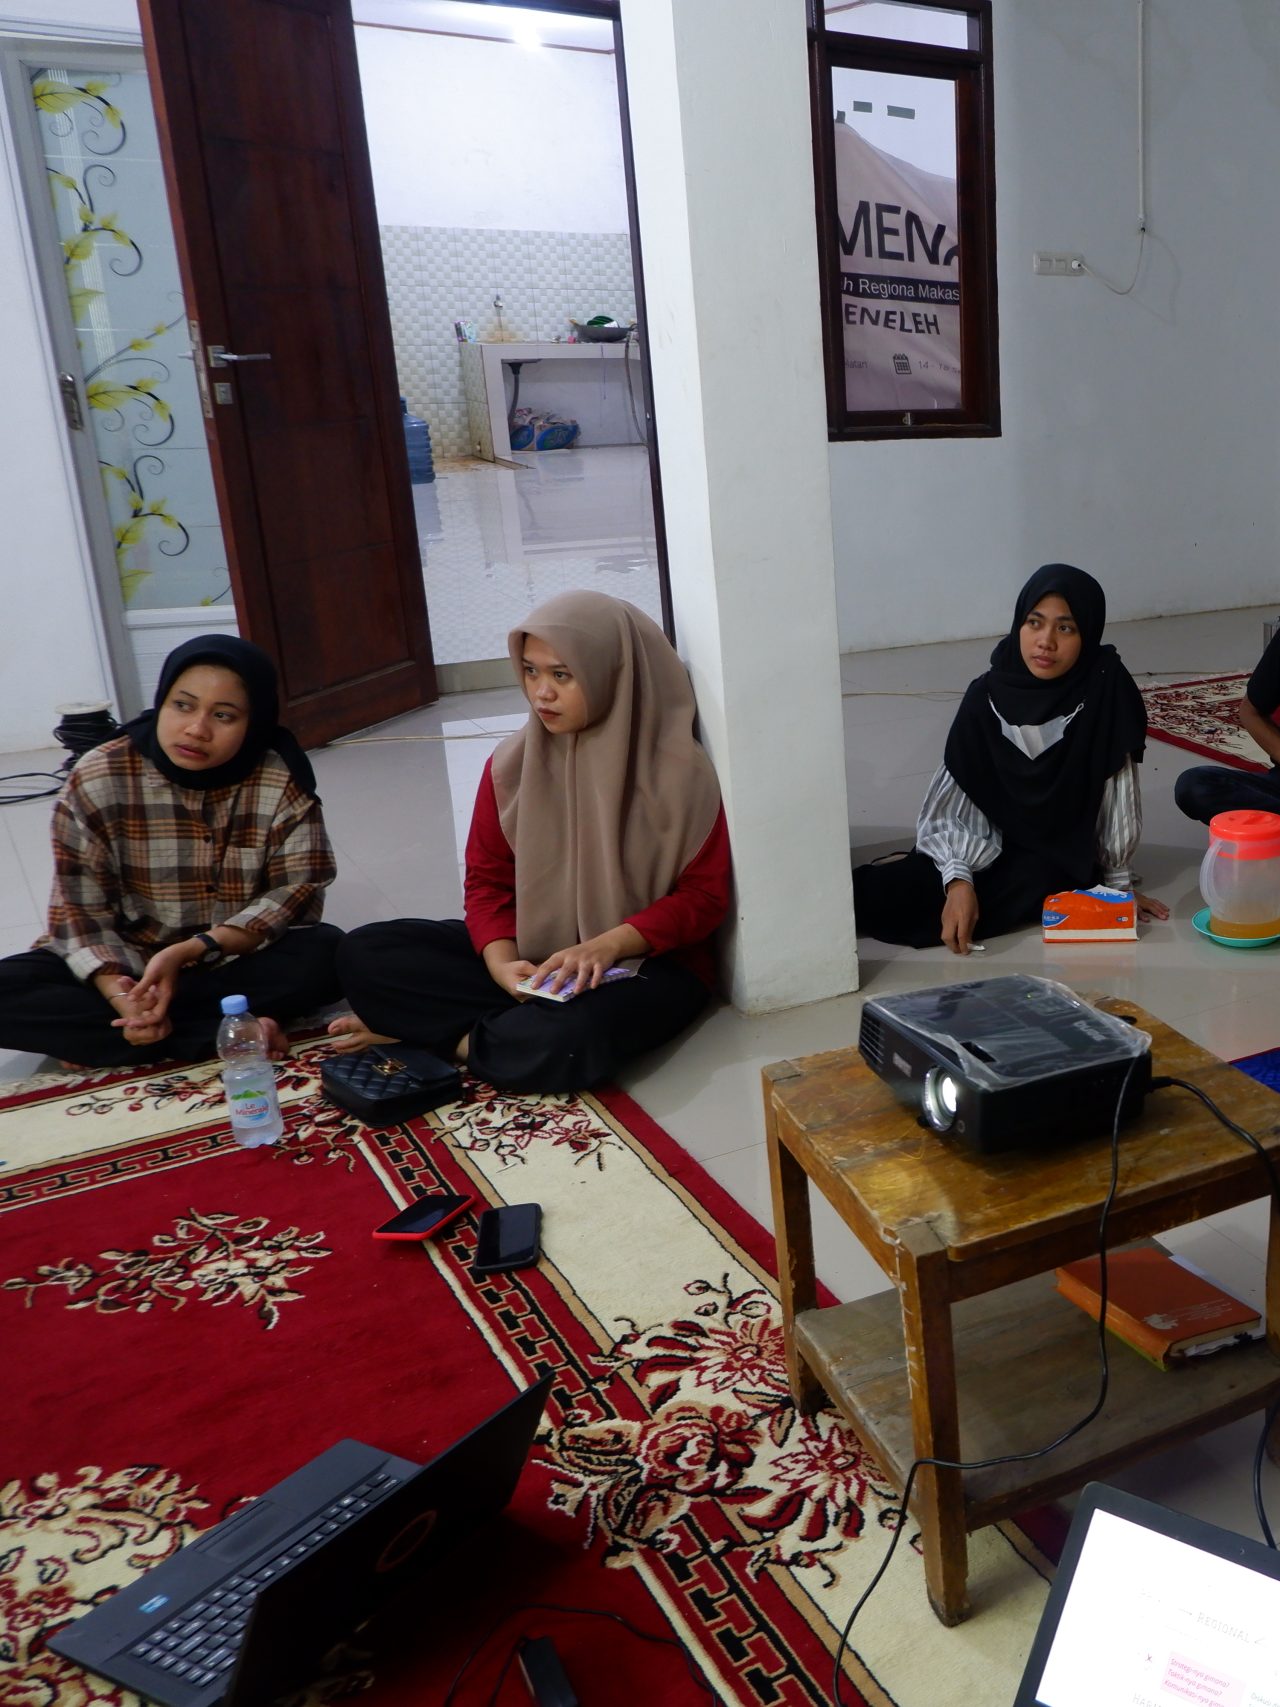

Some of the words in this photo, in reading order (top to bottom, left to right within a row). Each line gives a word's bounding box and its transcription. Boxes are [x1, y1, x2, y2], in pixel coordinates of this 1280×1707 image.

[837, 200, 959, 266] MEN
[859, 278, 915, 298] Regiona
[918, 283, 960, 301] Makas
[1196, 1611, 1251, 1644] REGIONAL
